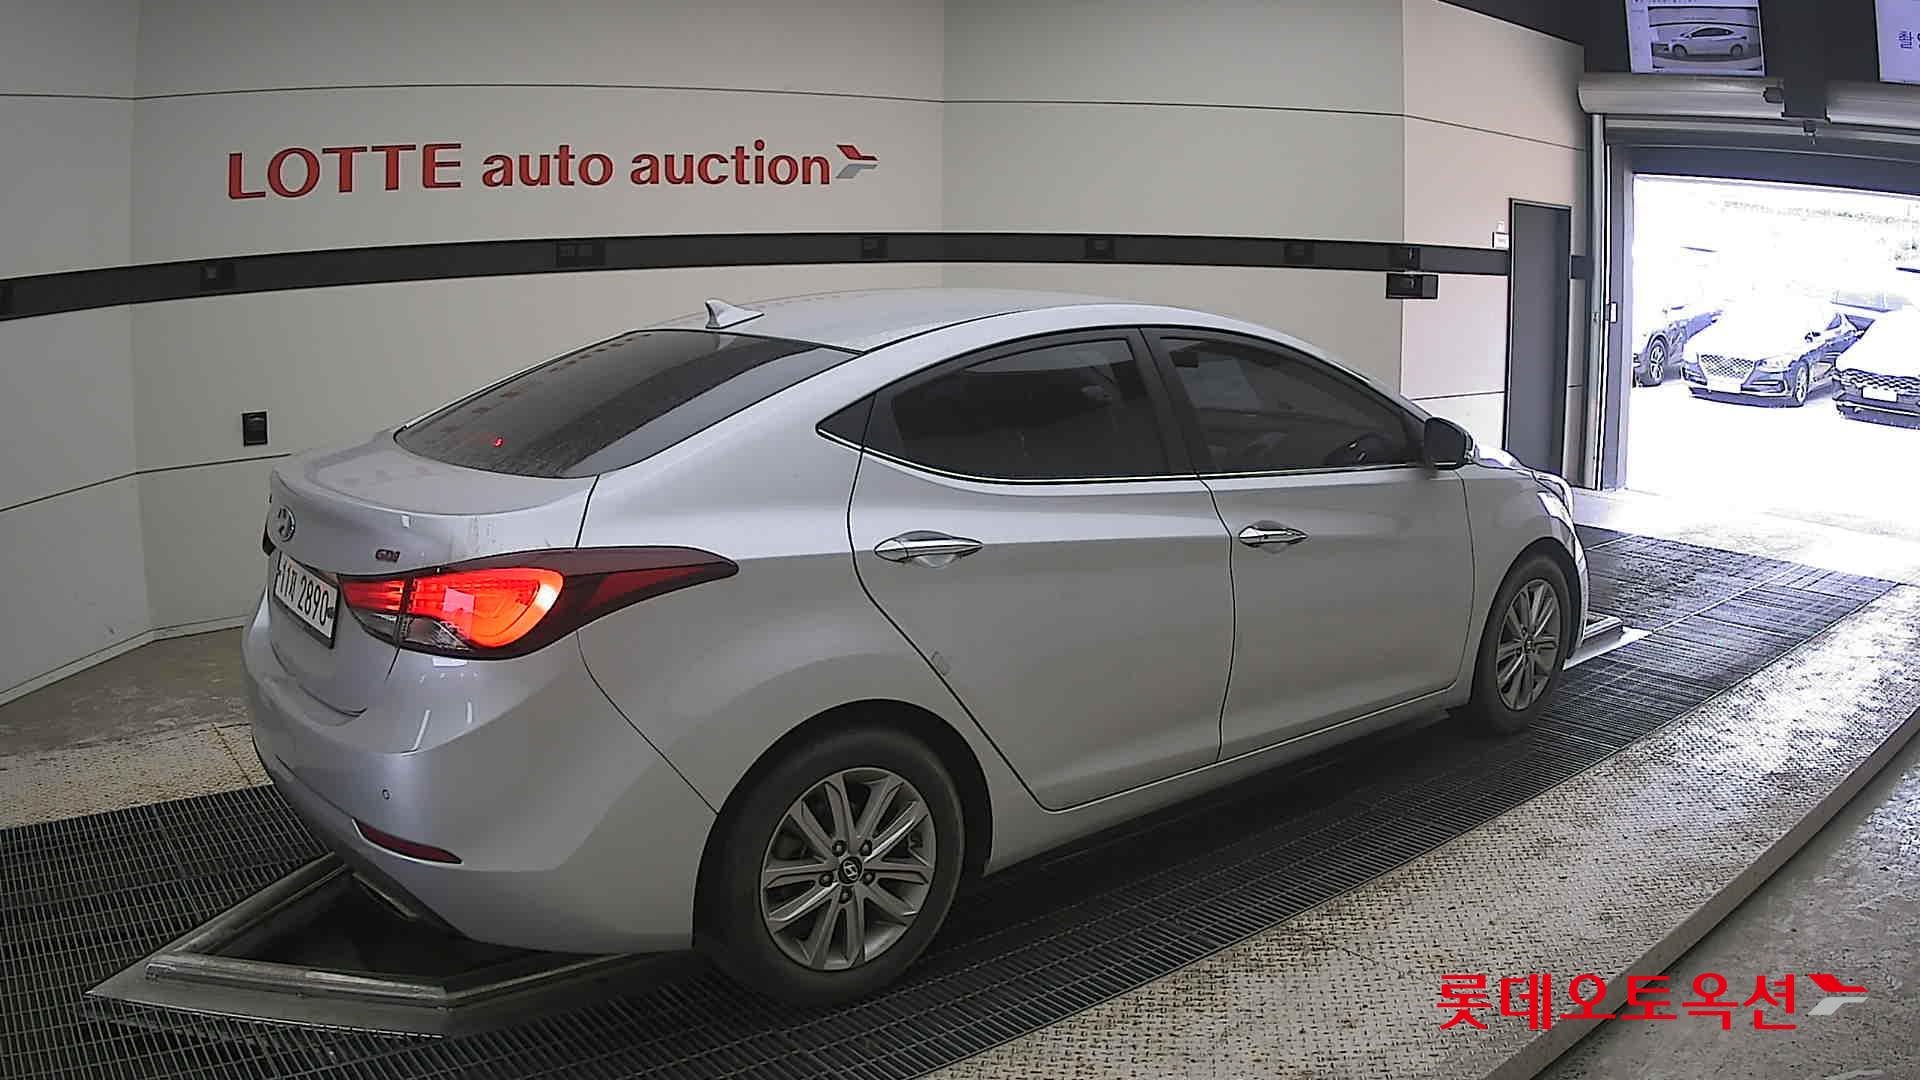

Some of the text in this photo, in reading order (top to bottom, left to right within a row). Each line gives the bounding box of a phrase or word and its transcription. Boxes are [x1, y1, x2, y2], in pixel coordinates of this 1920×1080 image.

[228, 139, 830, 200] LOTTE auto auction
[298, 574, 329, 626] 2890
